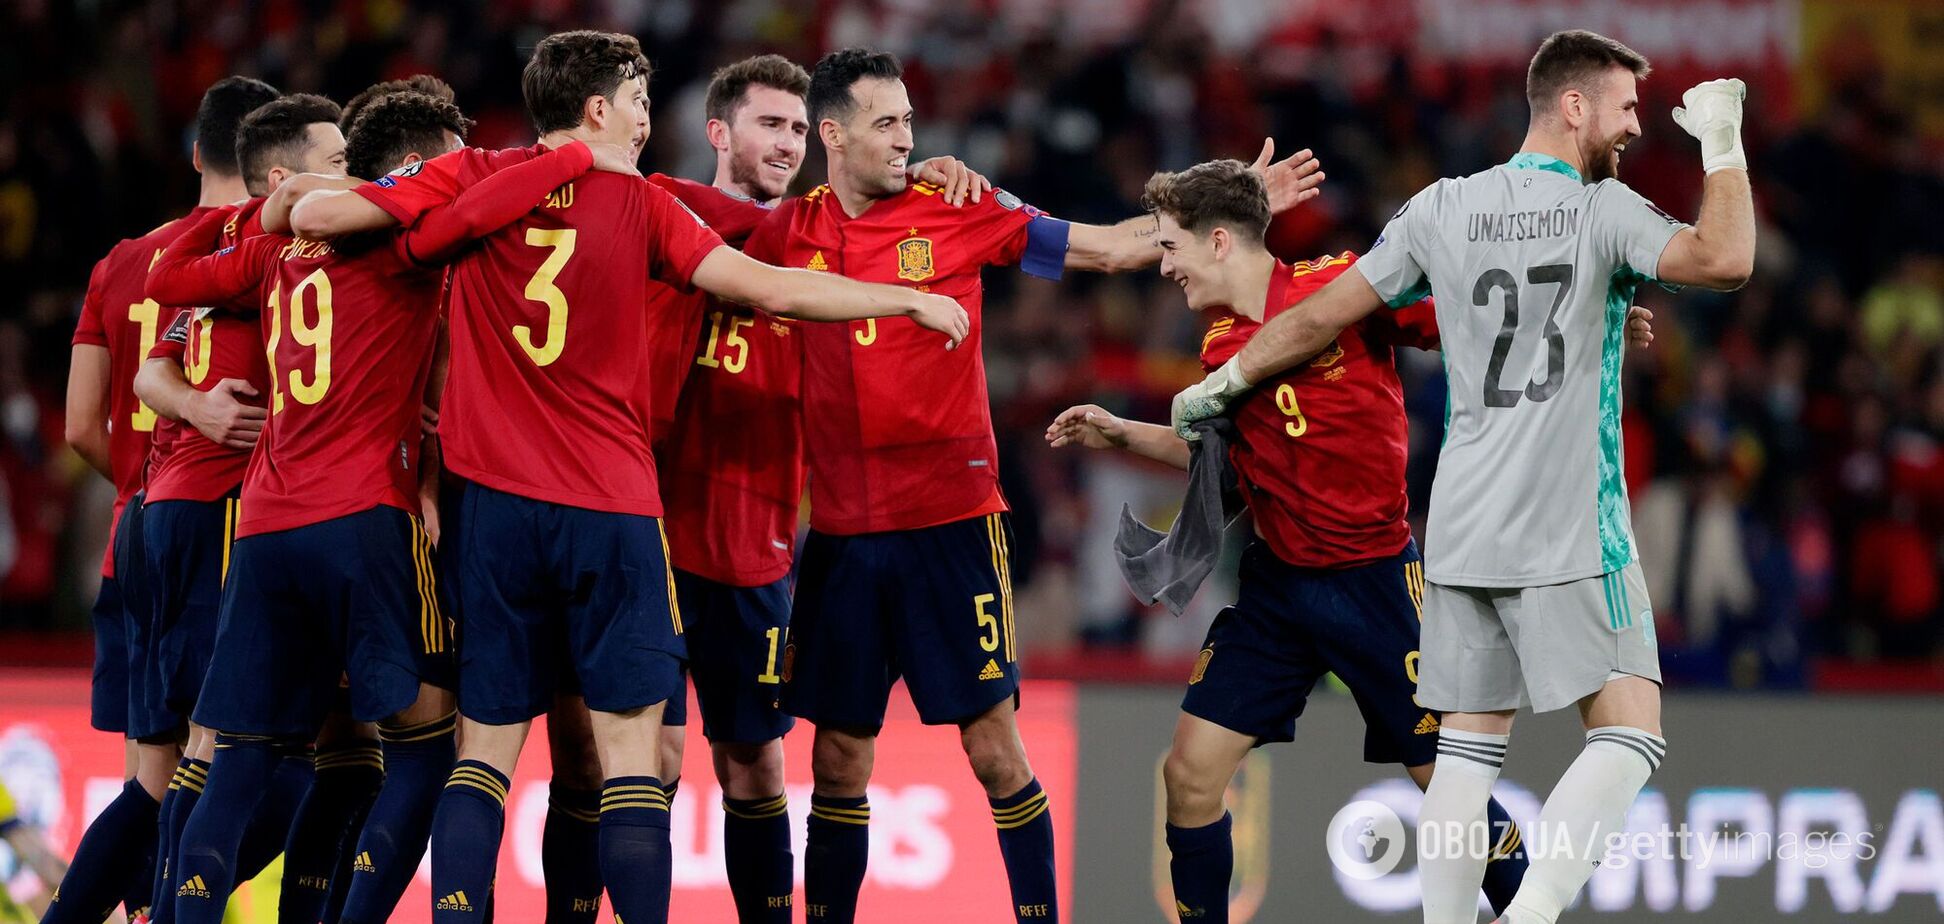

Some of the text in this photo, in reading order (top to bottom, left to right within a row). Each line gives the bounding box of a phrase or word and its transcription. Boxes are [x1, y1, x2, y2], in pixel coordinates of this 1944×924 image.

[511, 227, 577, 366] 3
[266, 267, 334, 416] 19
[697, 312, 754, 374] 15
[1472, 263, 1573, 408] 23
[1275, 384, 1307, 437] 9
[974, 593, 999, 652] 5
[978, 670, 1004, 681] adidas
[177, 888, 211, 899] adidas
[436, 902, 473, 912] adidas
[1019, 904, 1048, 917] RFEF
